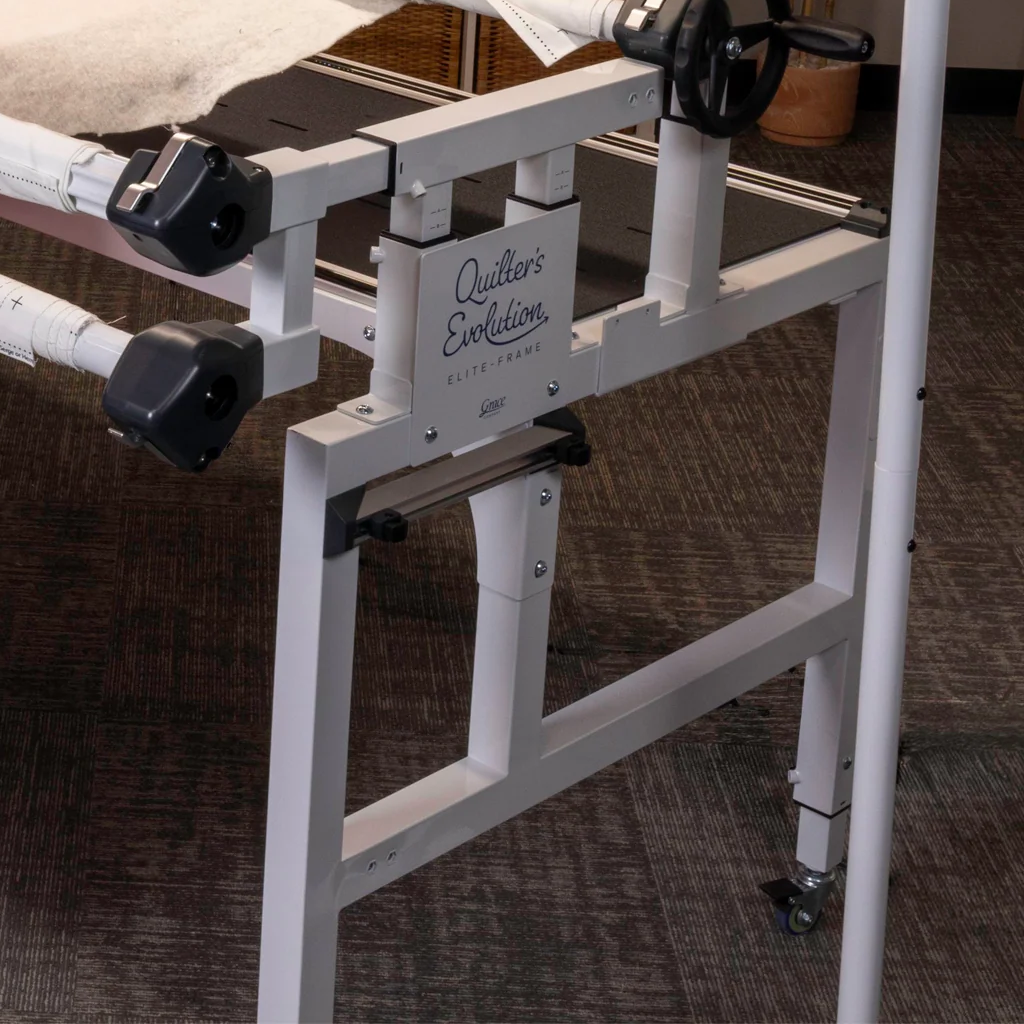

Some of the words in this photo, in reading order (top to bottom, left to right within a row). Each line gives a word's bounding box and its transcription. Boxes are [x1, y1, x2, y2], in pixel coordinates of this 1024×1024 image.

[455, 247, 545, 305] Quilter's
[443, 298, 549, 357] Evolution
[448, 342, 542, 385] ELITE-FRAME
[479, 396, 506, 418] Grace
